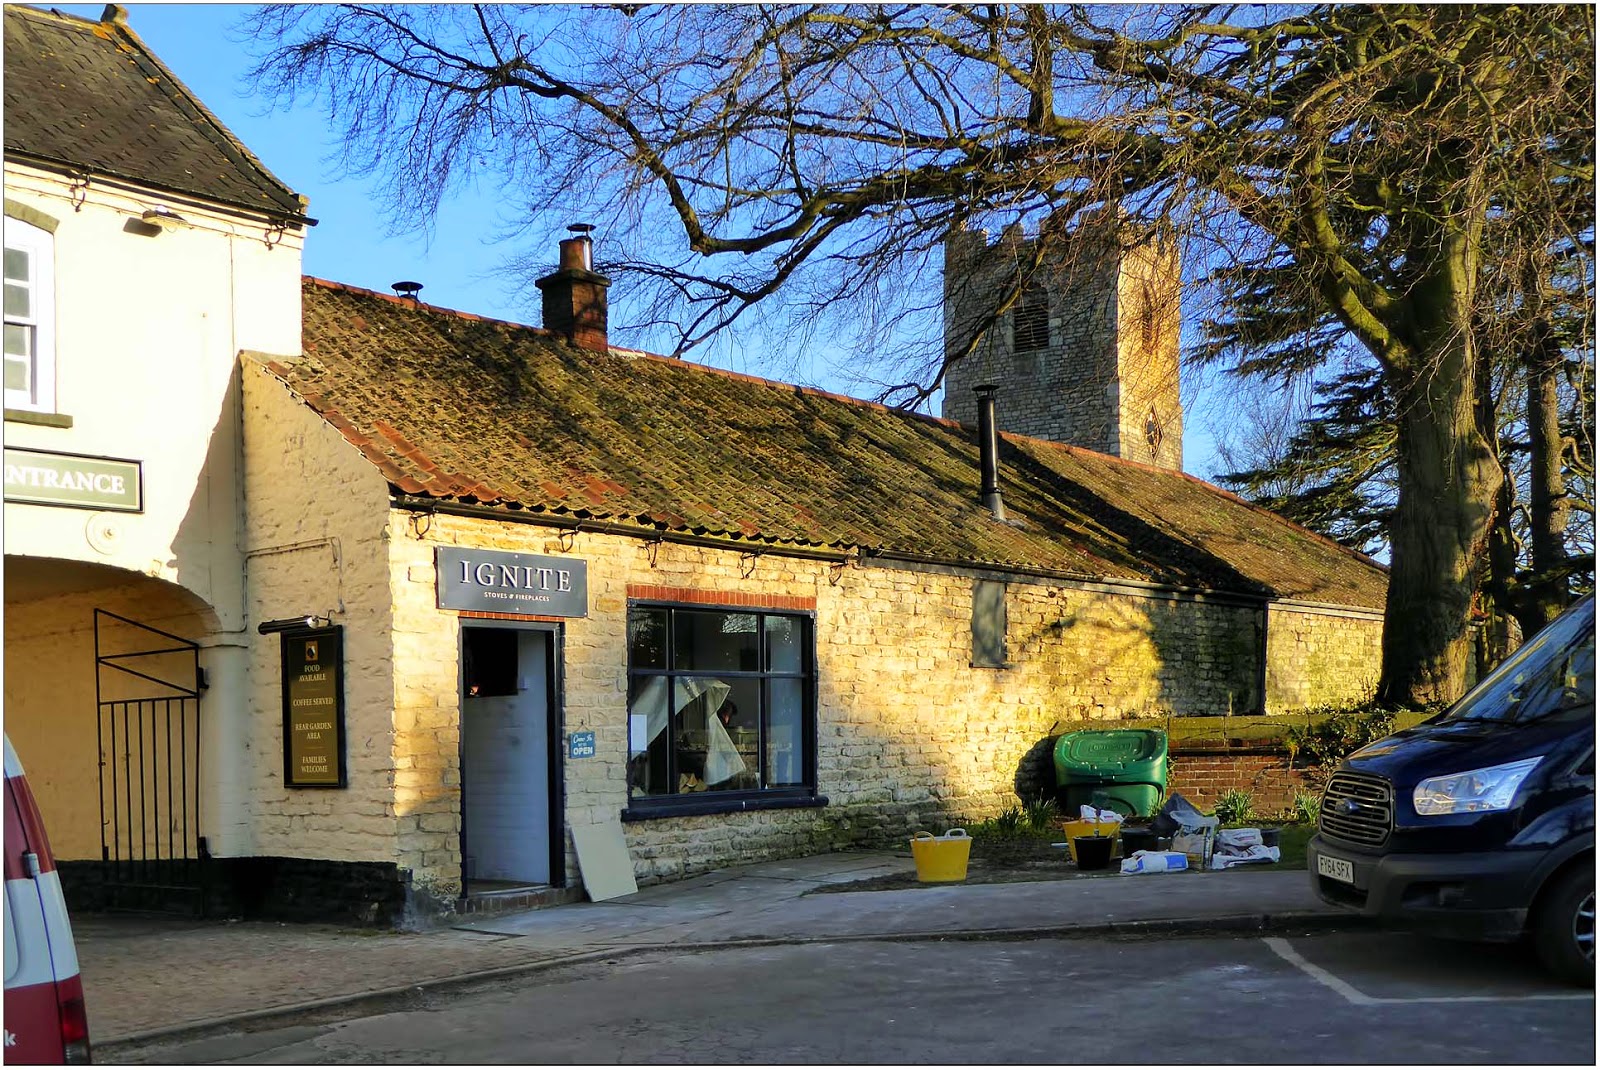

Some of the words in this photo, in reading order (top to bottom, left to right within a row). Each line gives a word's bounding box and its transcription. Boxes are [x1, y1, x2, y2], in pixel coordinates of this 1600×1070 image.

[4, 465, 125, 494] NTRANCE
[460, 560, 572, 592] IGNITE
[515, 594, 550, 602] FIREPLACES
[304, 664, 320, 672] FOOD
[299, 673, 326, 682] AVAILABLE
[293, 698, 313, 706] COFFEE
[313, 697, 333, 705] SERVED
[295, 723, 309, 731] REAR
[309, 722, 332, 730] GARDEN
[306, 732, 321, 740] AREA
[573, 746, 593, 755] OPEN
[302, 755, 327, 764] FAMILIES
[301, 765, 328, 773] WELCOME
[1320, 857, 1335, 873] FY64
[1336, 861, 1350, 878] SFX
[4, 1028, 17, 1047] k
